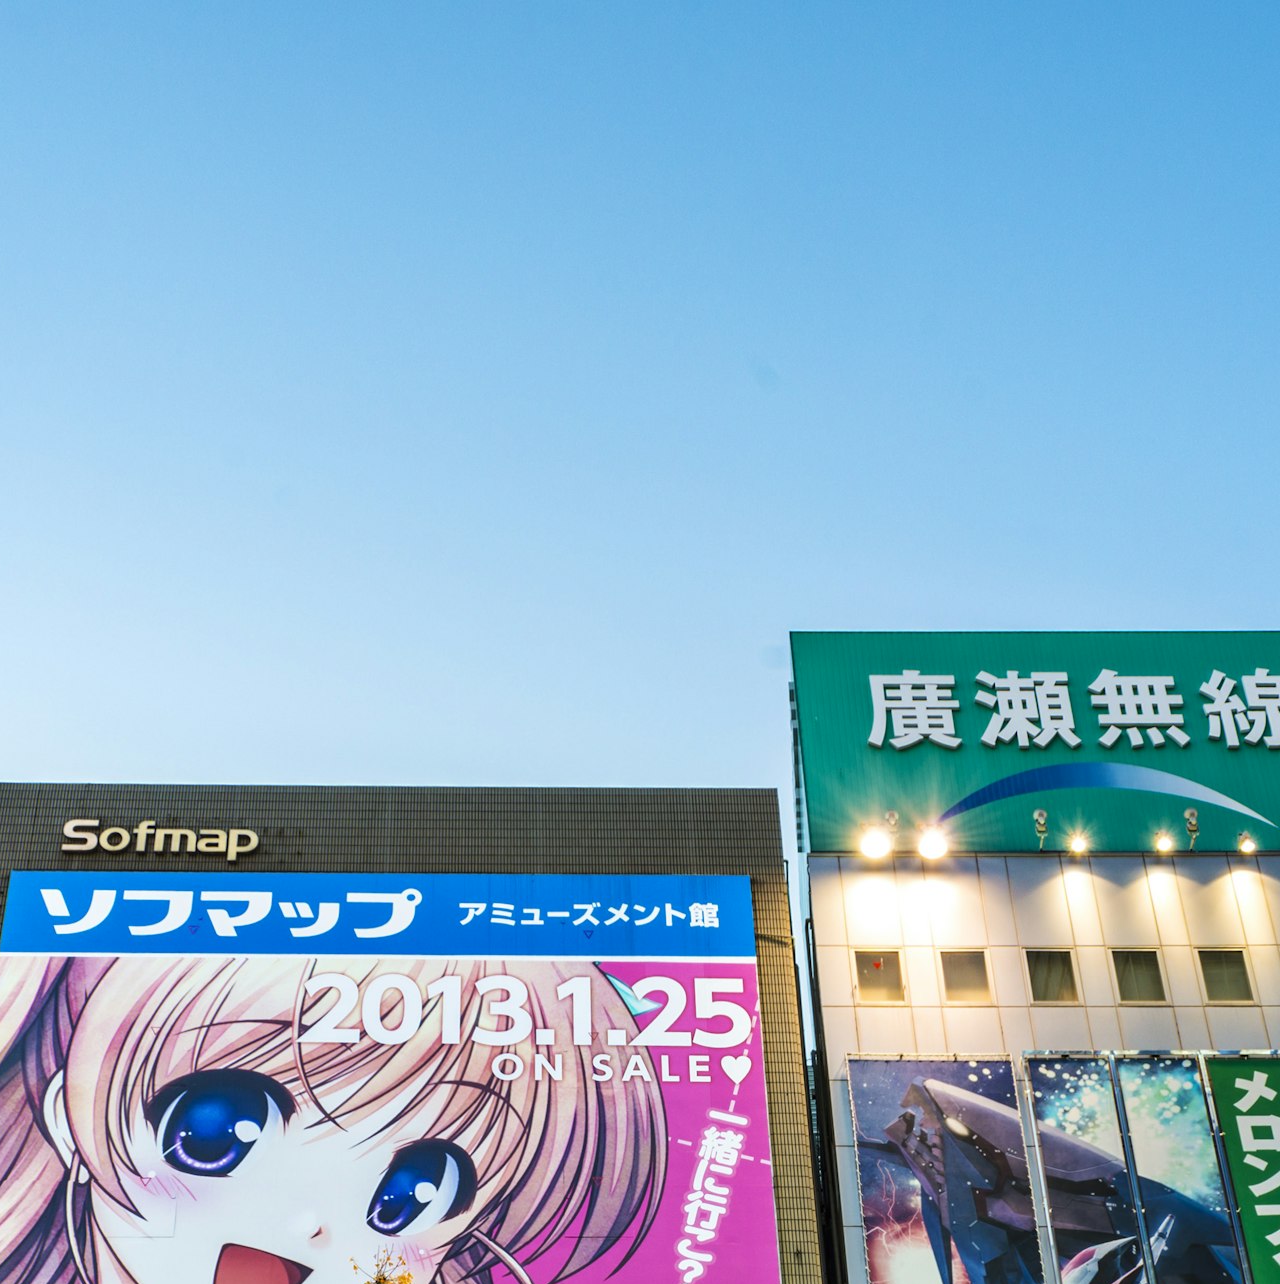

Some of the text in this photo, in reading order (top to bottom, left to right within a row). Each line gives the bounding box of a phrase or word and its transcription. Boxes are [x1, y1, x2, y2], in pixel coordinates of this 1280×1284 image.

[62, 820, 259, 861] Sofmap
[41, 889, 422, 938] ソフマップ
[458, 901, 720, 928] アミューズメント館
[298, 973, 755, 1047] 2013.1.25
[491, 1053, 714, 1084] ON SALE
